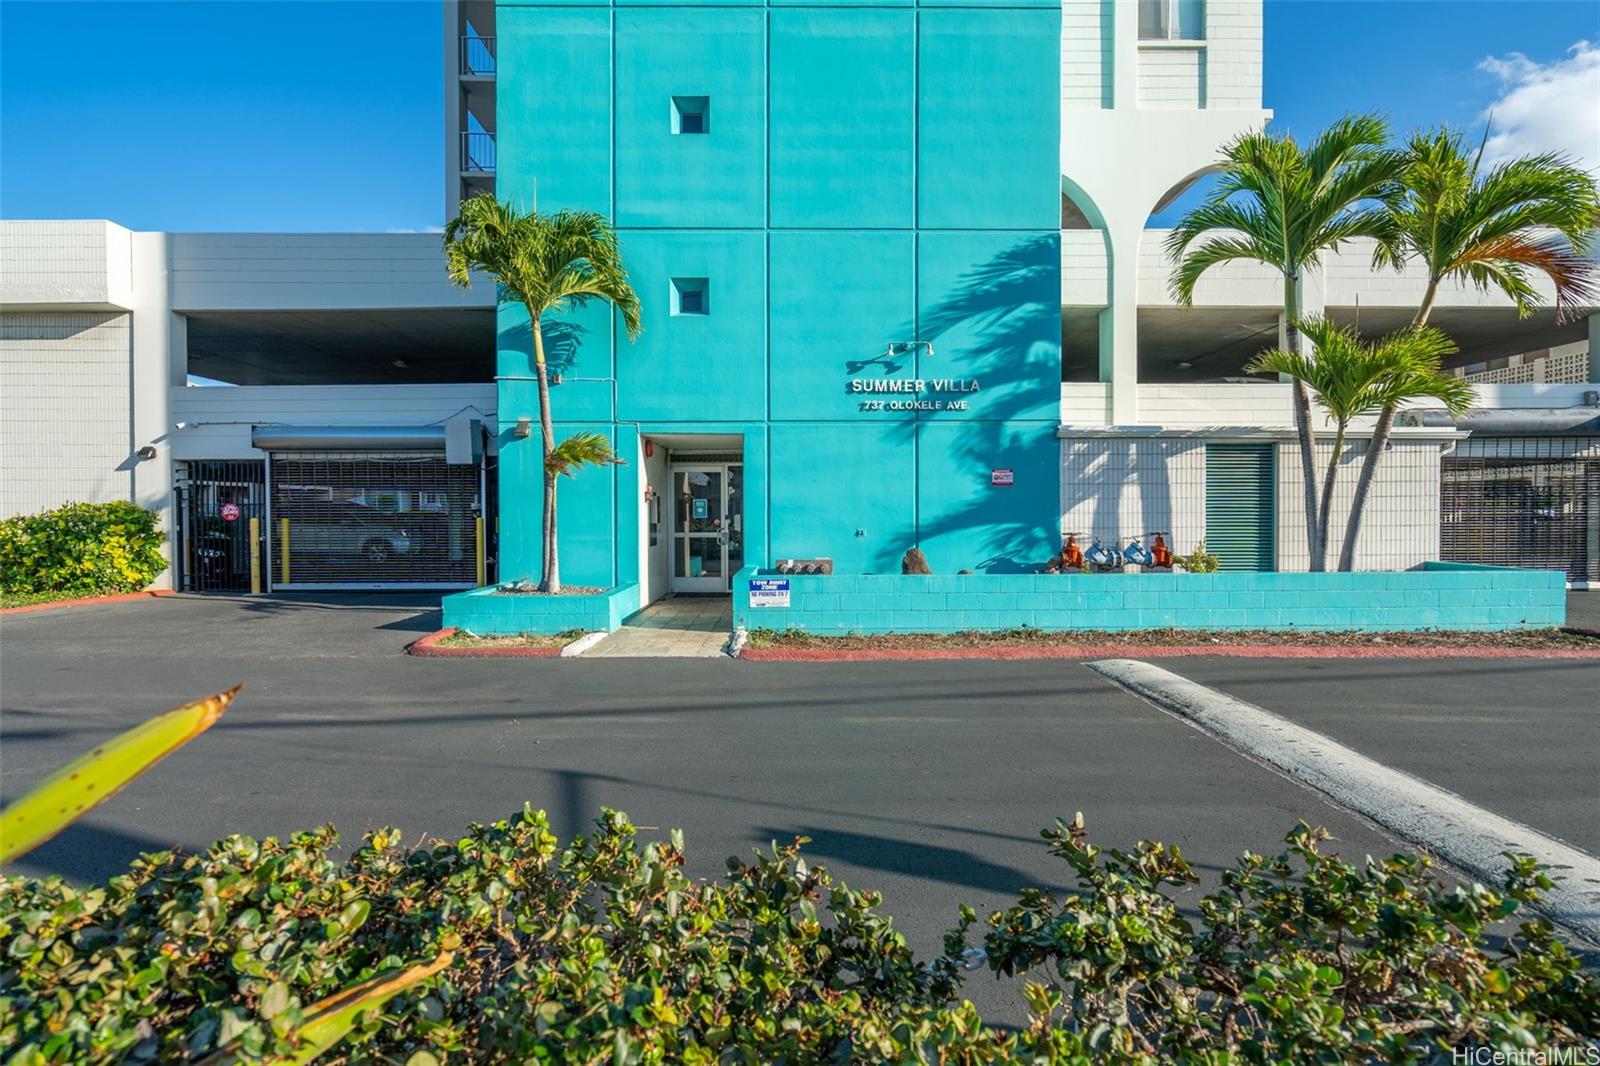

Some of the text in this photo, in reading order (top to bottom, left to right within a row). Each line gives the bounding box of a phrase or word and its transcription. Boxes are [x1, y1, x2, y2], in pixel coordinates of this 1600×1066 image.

[852, 379, 981, 392] SUMMER VILLA
[864, 400, 885, 410] 737
[890, 400, 941, 410] OLOKELE
